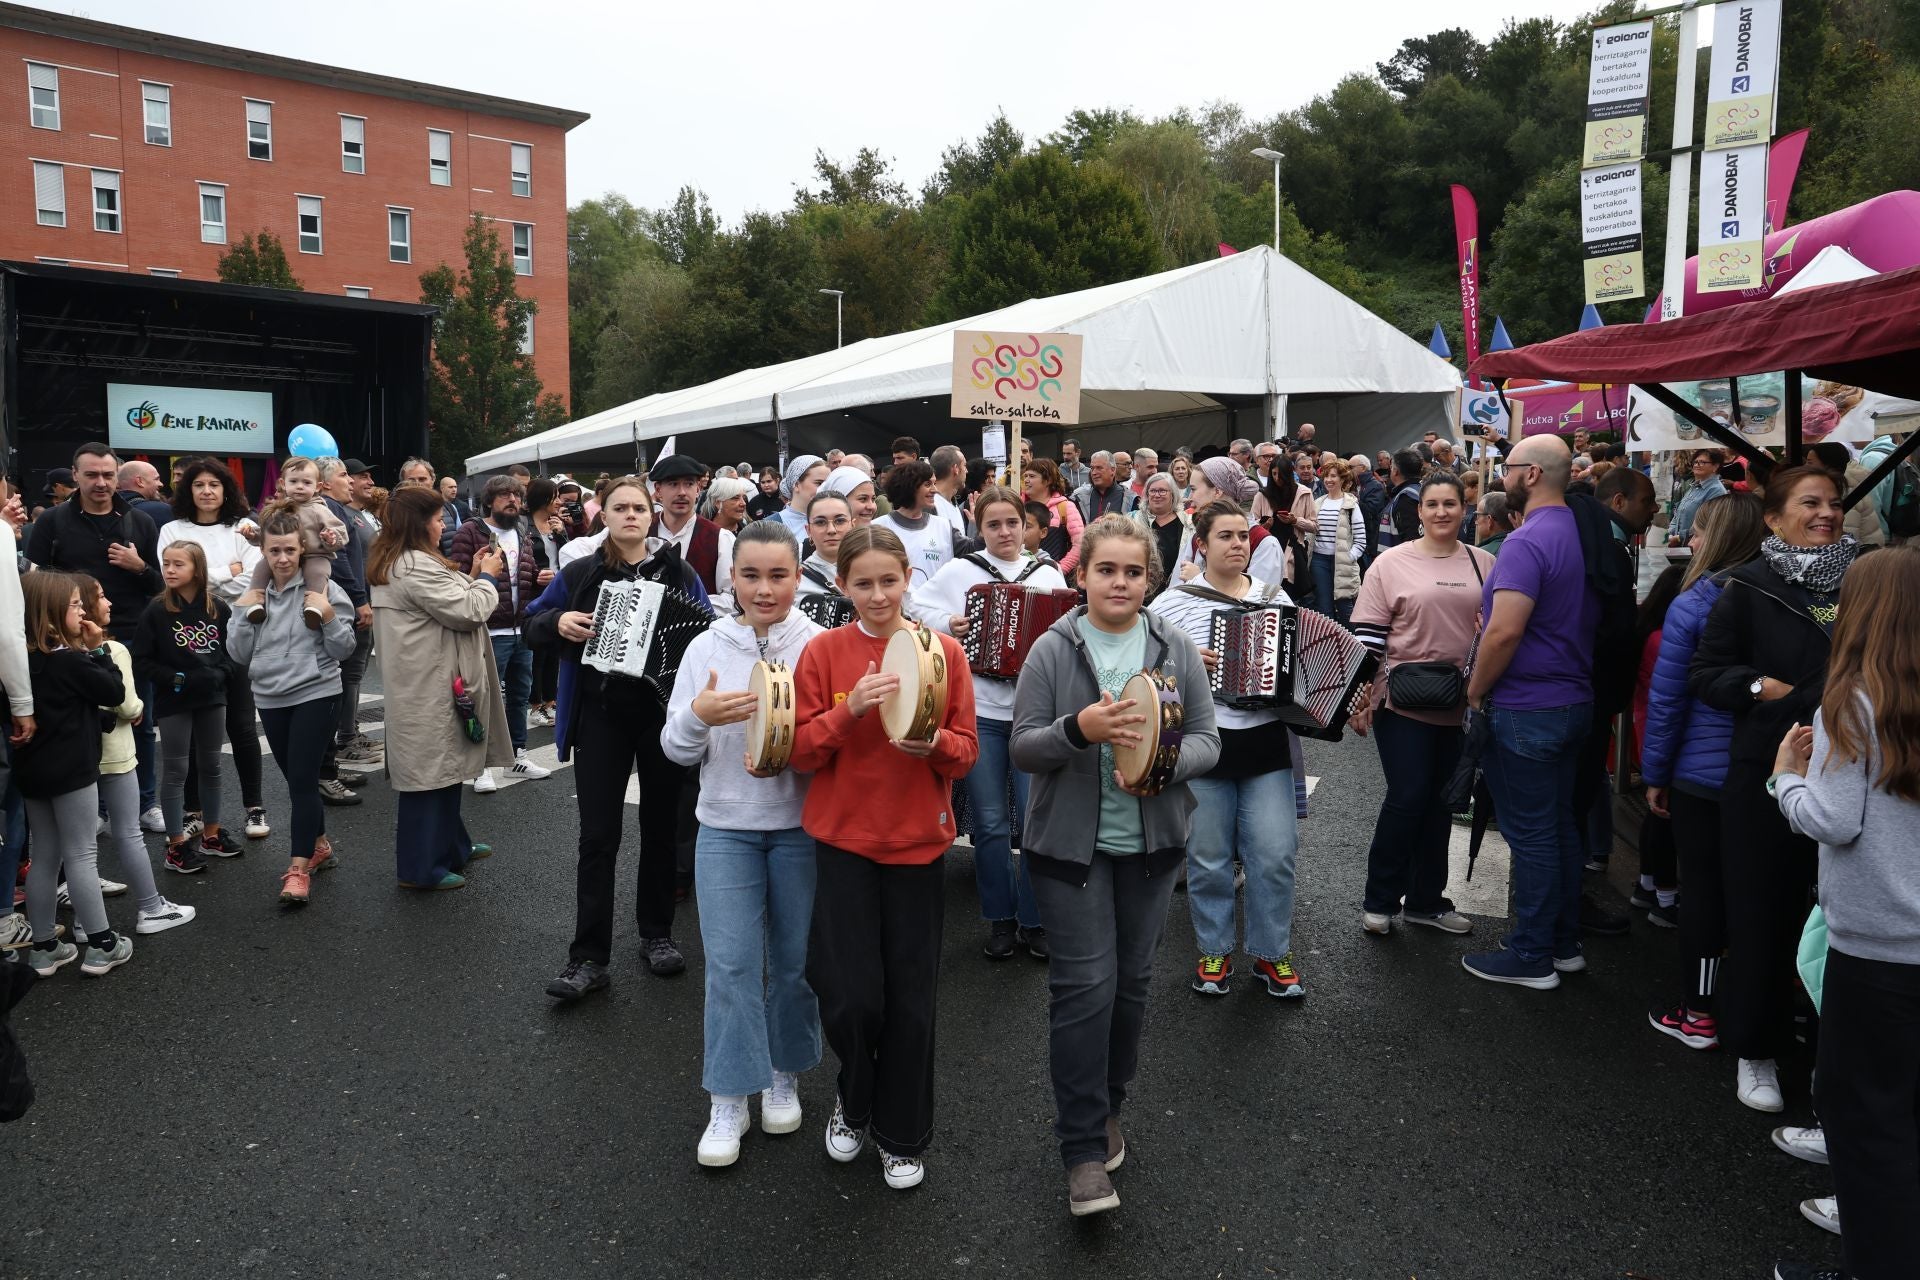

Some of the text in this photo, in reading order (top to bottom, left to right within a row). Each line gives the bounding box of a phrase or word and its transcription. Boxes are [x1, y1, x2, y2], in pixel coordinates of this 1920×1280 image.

[1606, 30, 1650, 44] goiener
[1736, 7, 1753, 72] DANOBAT
[1594, 48, 1647, 61] berriztagarria
[1602, 61, 1637, 71] bertakoa
[1596, 72, 1641, 83] euskalduna
[1592, 84, 1643, 95] kooperatiboa
[1594, 168, 1637, 184] goiener
[1725, 153, 1739, 217] DANOBAT
[1584, 185, 1637, 200] berriztagarria
[1593, 199, 1628, 210] bertakoa
[1589, 209, 1633, 221] euskalduna
[1586, 220, 1637, 234] kooperatiboa
[970, 401, 1061, 419] salto-saltoka
[161, 413, 251, 431] ENE KANTAK
[1526, 415, 1553, 425] kutxa
